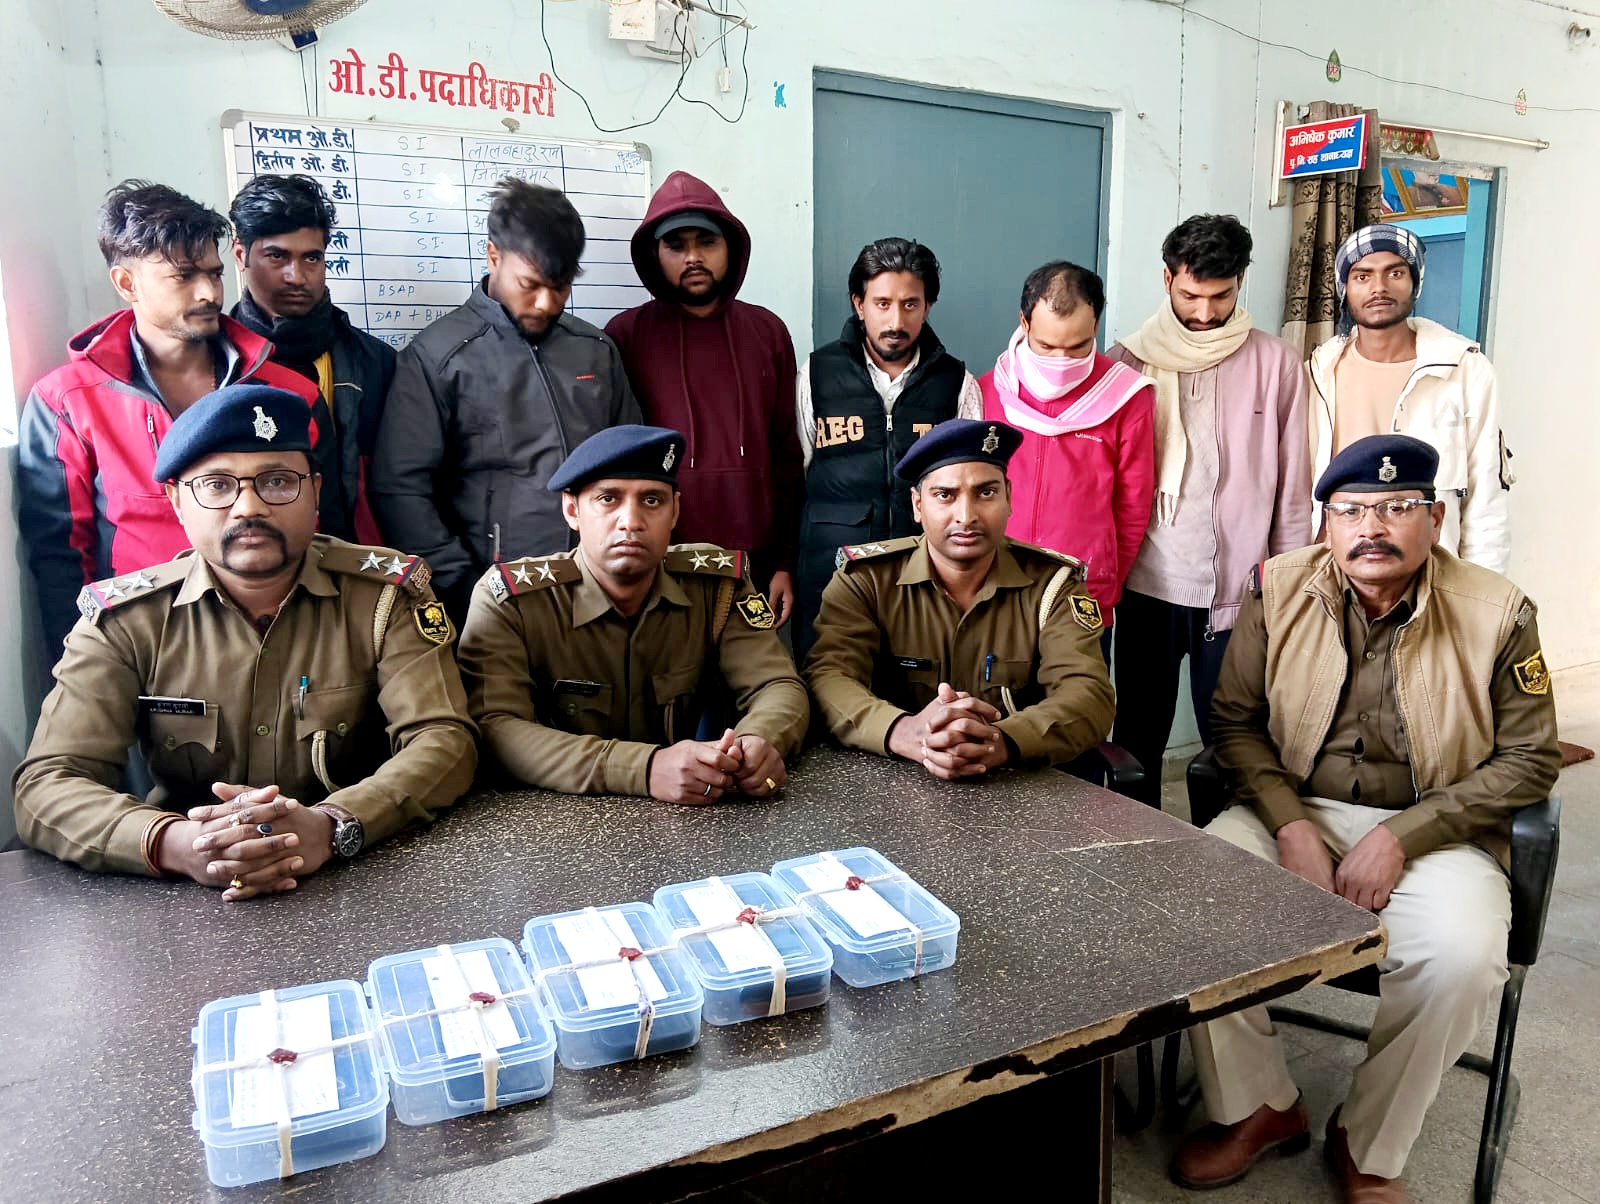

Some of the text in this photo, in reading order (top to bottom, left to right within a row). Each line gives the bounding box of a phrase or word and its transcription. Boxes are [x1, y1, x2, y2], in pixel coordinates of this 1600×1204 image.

[253, 126, 302, 146] प्रथम
[1327, 126, 1356, 144] कुमार
[379, 285, 415, 297] BSAP
